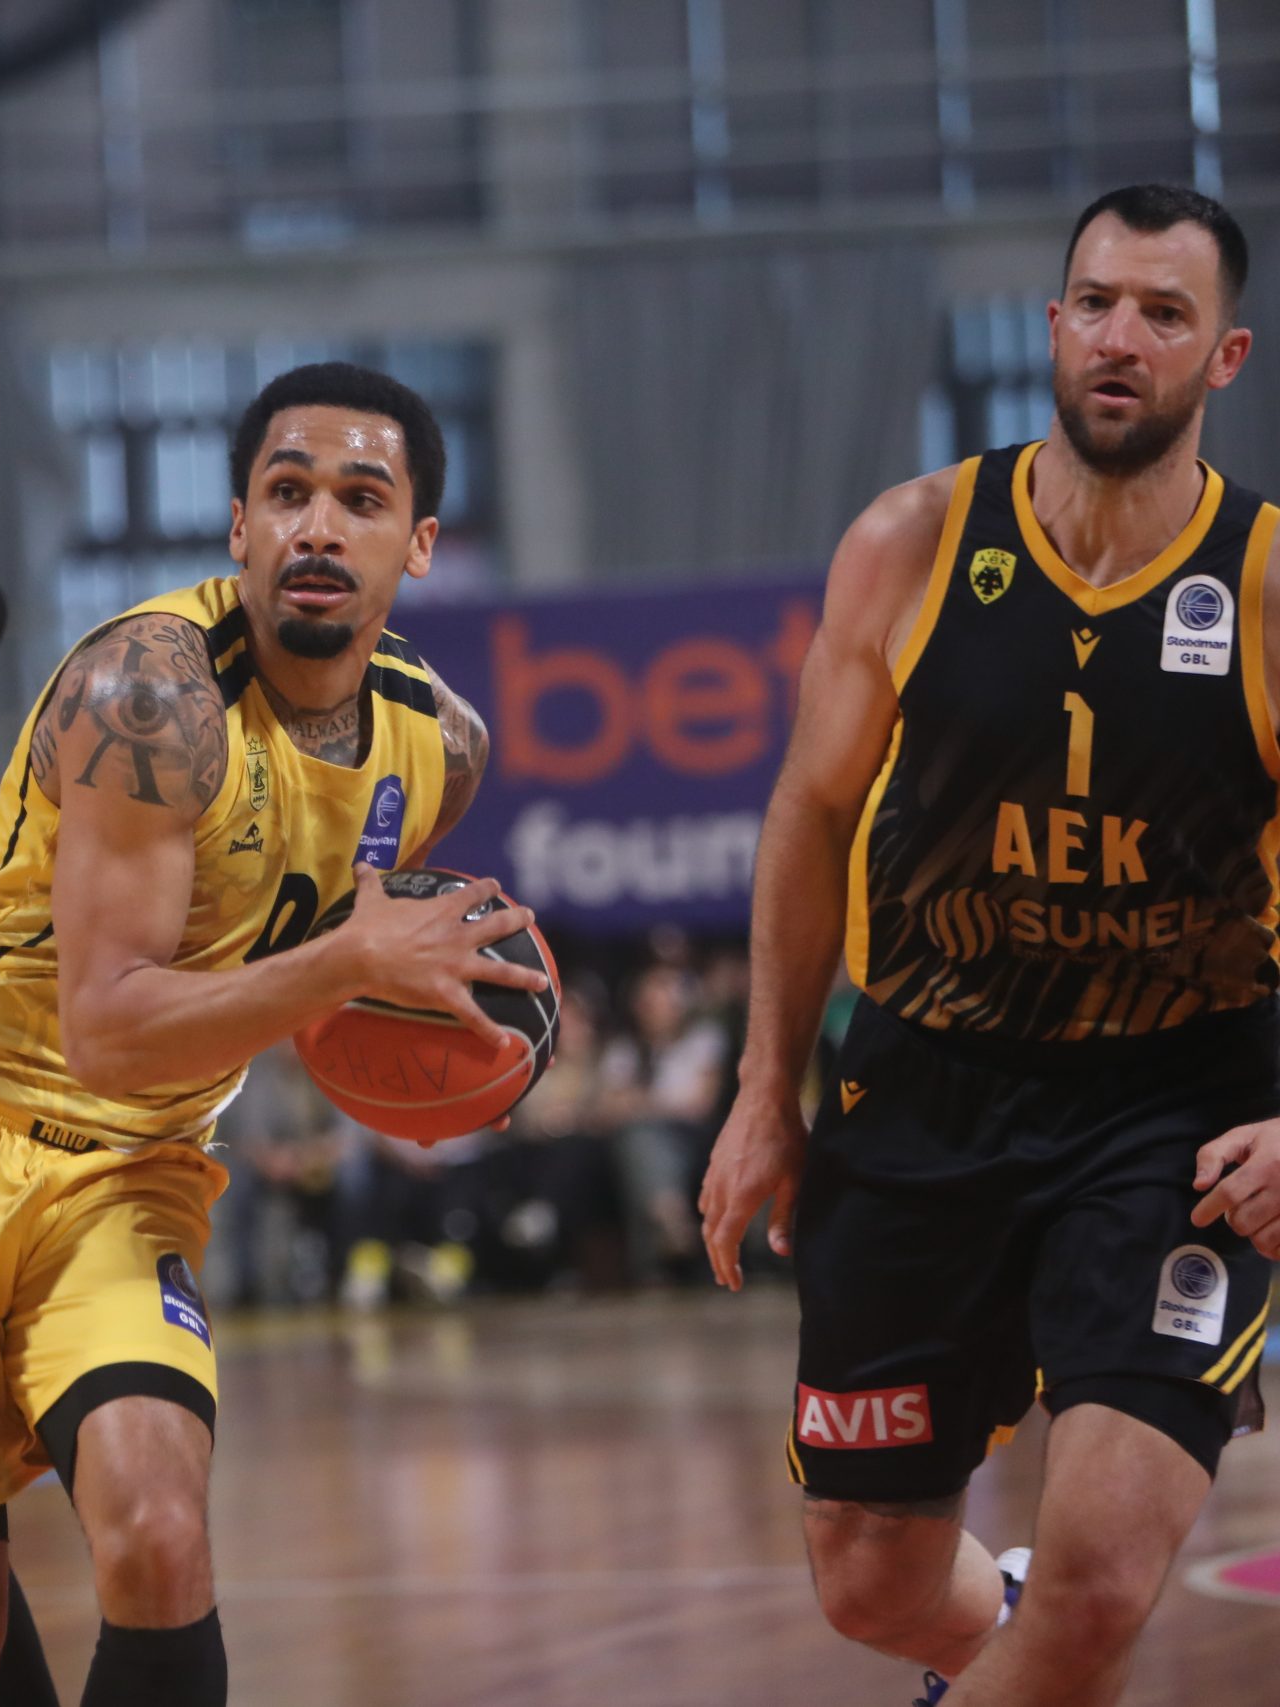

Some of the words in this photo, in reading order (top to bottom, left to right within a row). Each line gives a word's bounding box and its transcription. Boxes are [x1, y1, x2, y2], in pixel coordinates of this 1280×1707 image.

[1180, 652, 1211, 666] GBL
[1063, 691, 1095, 798] 1
[992, 801, 1148, 887] AEK
[1009, 896, 1216, 951] SUNEL
[1172, 1318, 1202, 1333] GBL
[799, 1392, 926, 1443] AVIS
